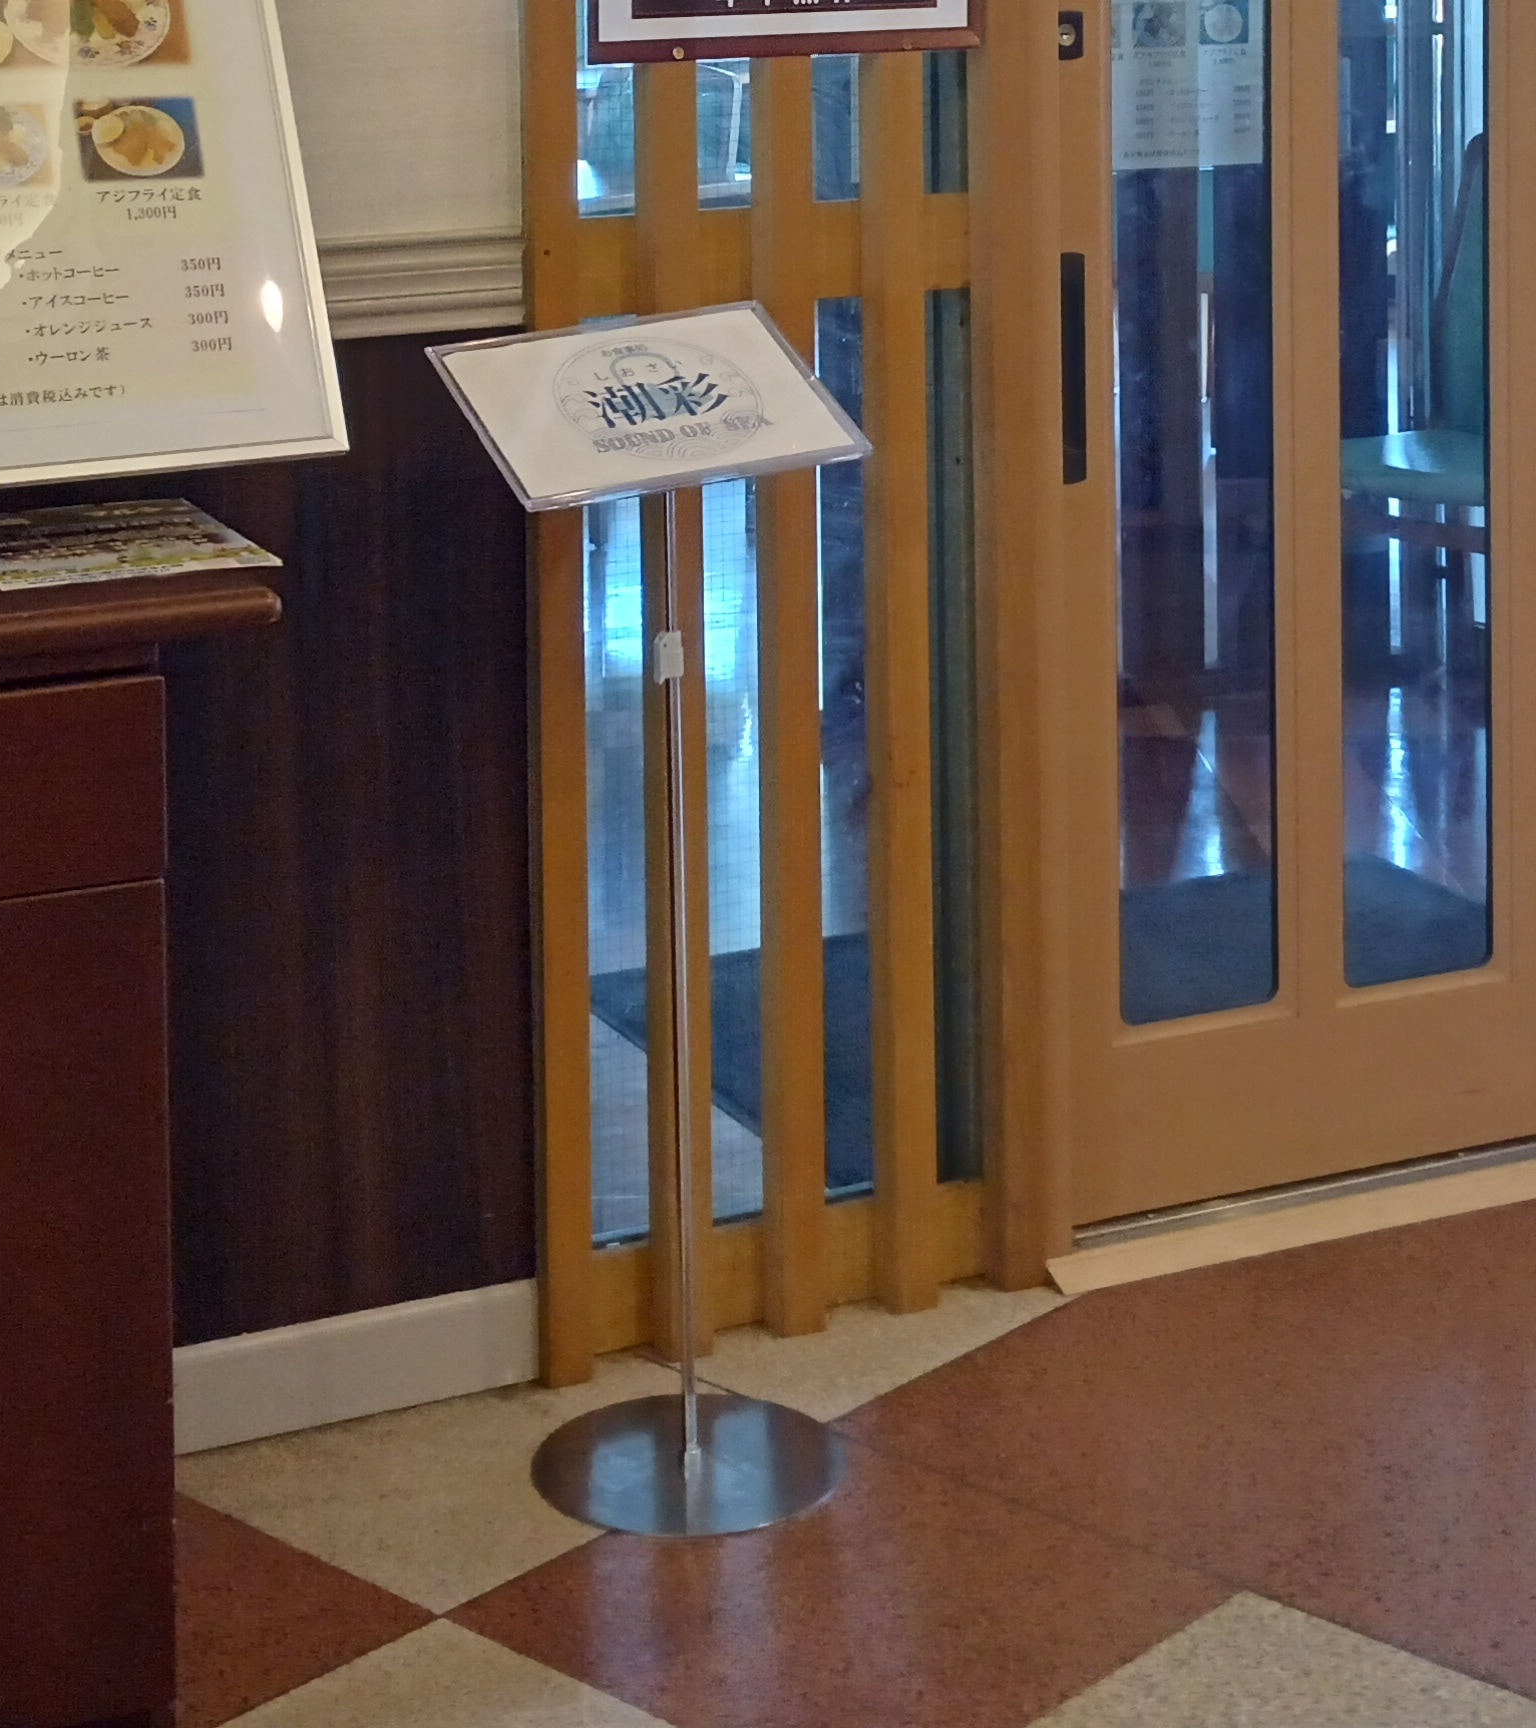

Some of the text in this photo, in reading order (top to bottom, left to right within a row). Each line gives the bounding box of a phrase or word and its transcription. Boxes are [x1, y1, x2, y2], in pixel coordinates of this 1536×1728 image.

[96, 186, 203, 203] アジフライ定食
[180, 256, 221, 272] 350円
[184, 283, 225, 299] 350円
[187, 310, 229, 326] 300円
[191, 337, 232, 353] 300円
[583, 373, 729, 429] 潮彩
[592, 428, 675, 454] SOUND
